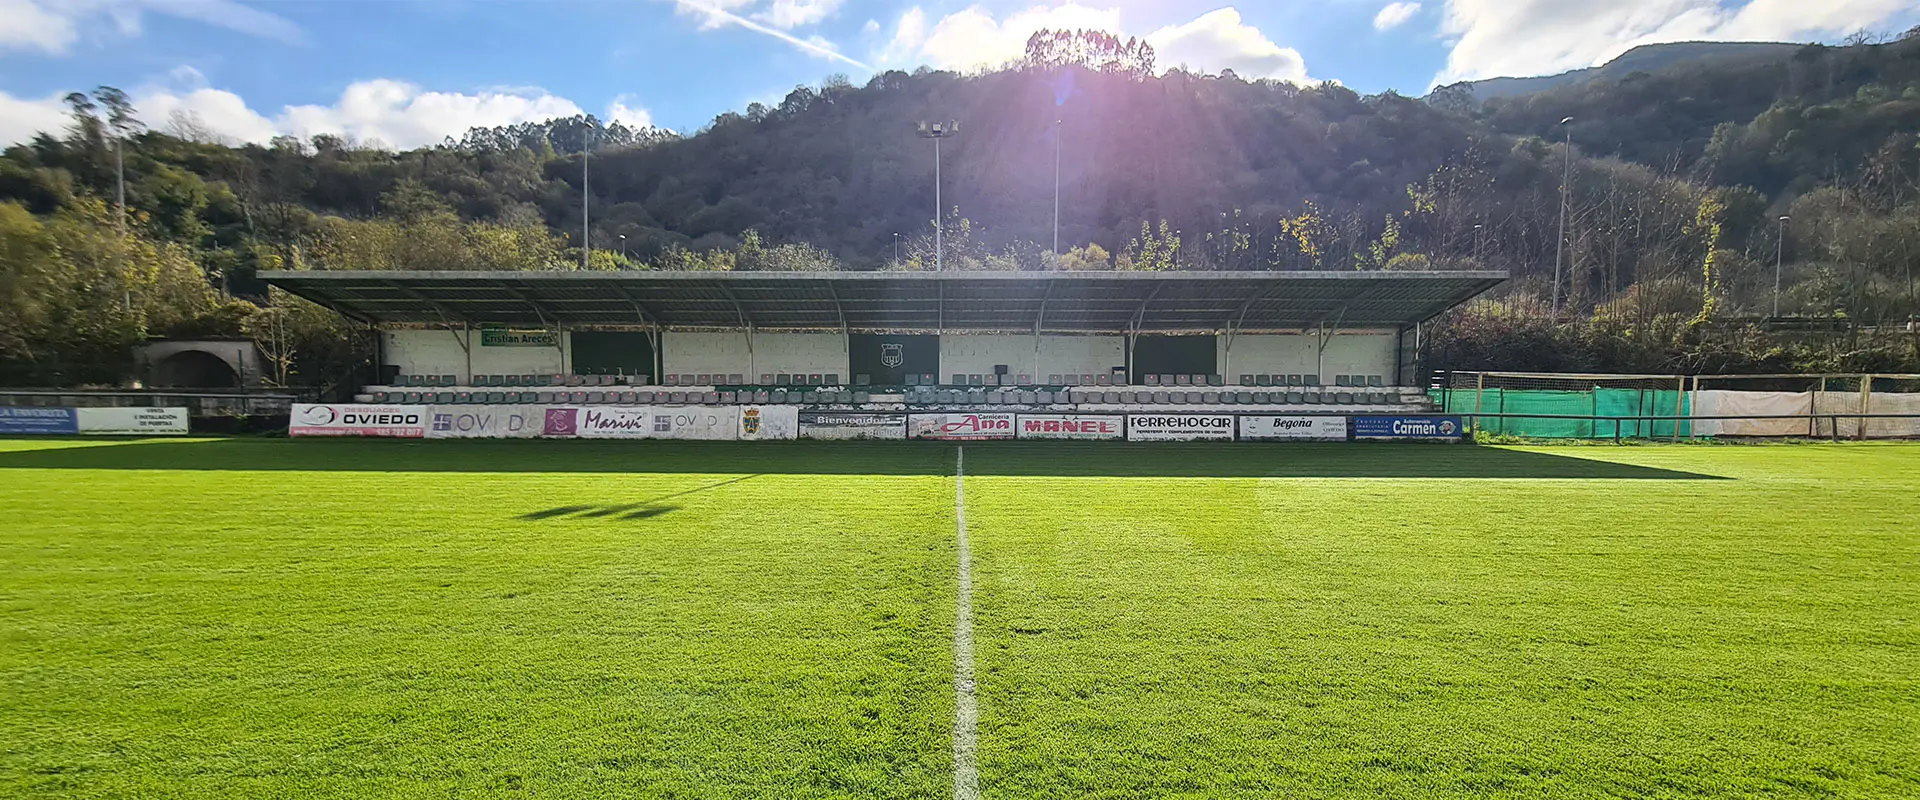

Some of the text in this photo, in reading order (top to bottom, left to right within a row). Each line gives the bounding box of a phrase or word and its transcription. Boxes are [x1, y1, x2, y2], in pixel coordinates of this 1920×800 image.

[484, 334, 553, 343] Cristian Areces
[14, 409, 70, 418] FAVORITA
[343, 414, 419, 425] OVIEDO
[940, 415, 1010, 432] Ana
[1130, 416, 1231, 428] FERREHOGAR
[1273, 417, 1312, 430] Begoña
[1393, 420, 1436, 434] Carmen
